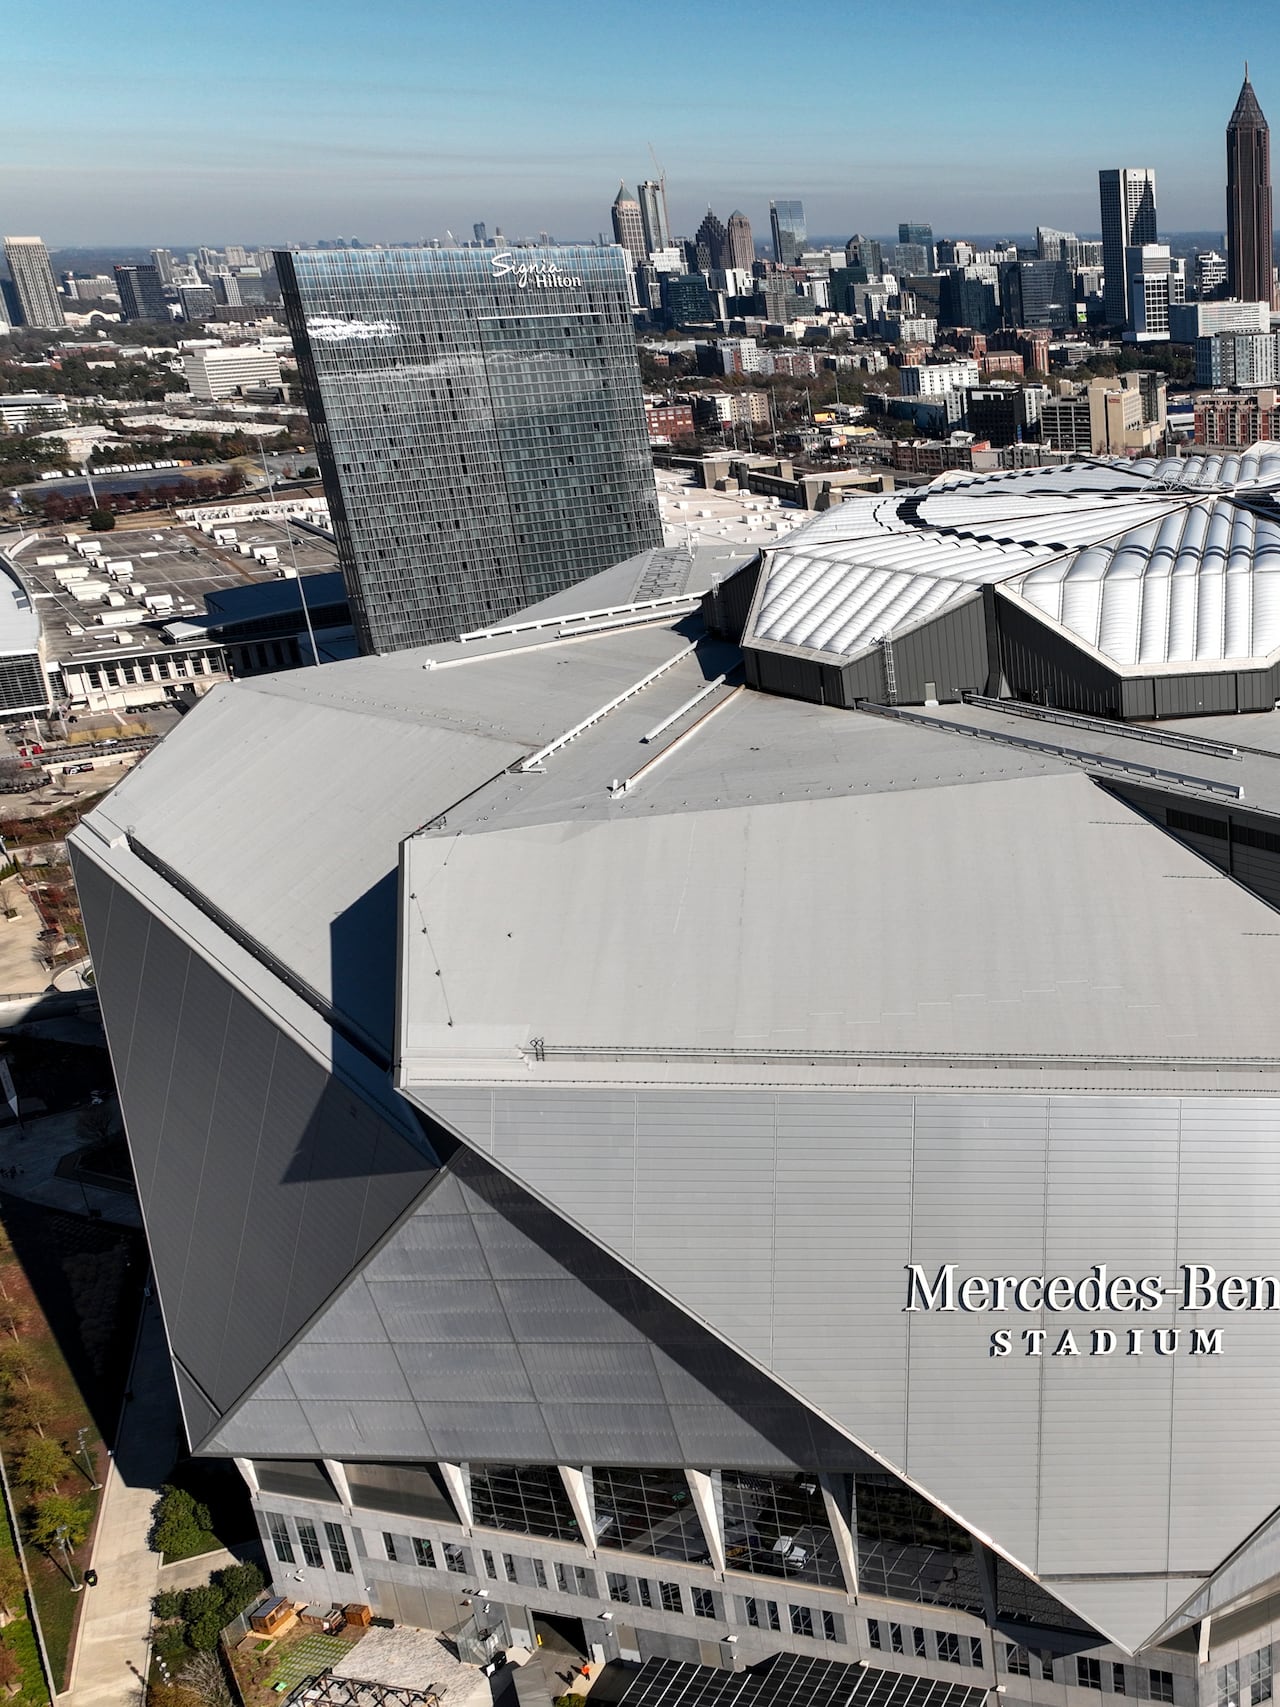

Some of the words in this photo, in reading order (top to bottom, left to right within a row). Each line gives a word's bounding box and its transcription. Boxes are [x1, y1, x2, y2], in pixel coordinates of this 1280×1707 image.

[490, 252, 564, 288] Signia
[535, 273, 582, 288] Hilton
[991, 1328, 1225, 1357] STADIUM
